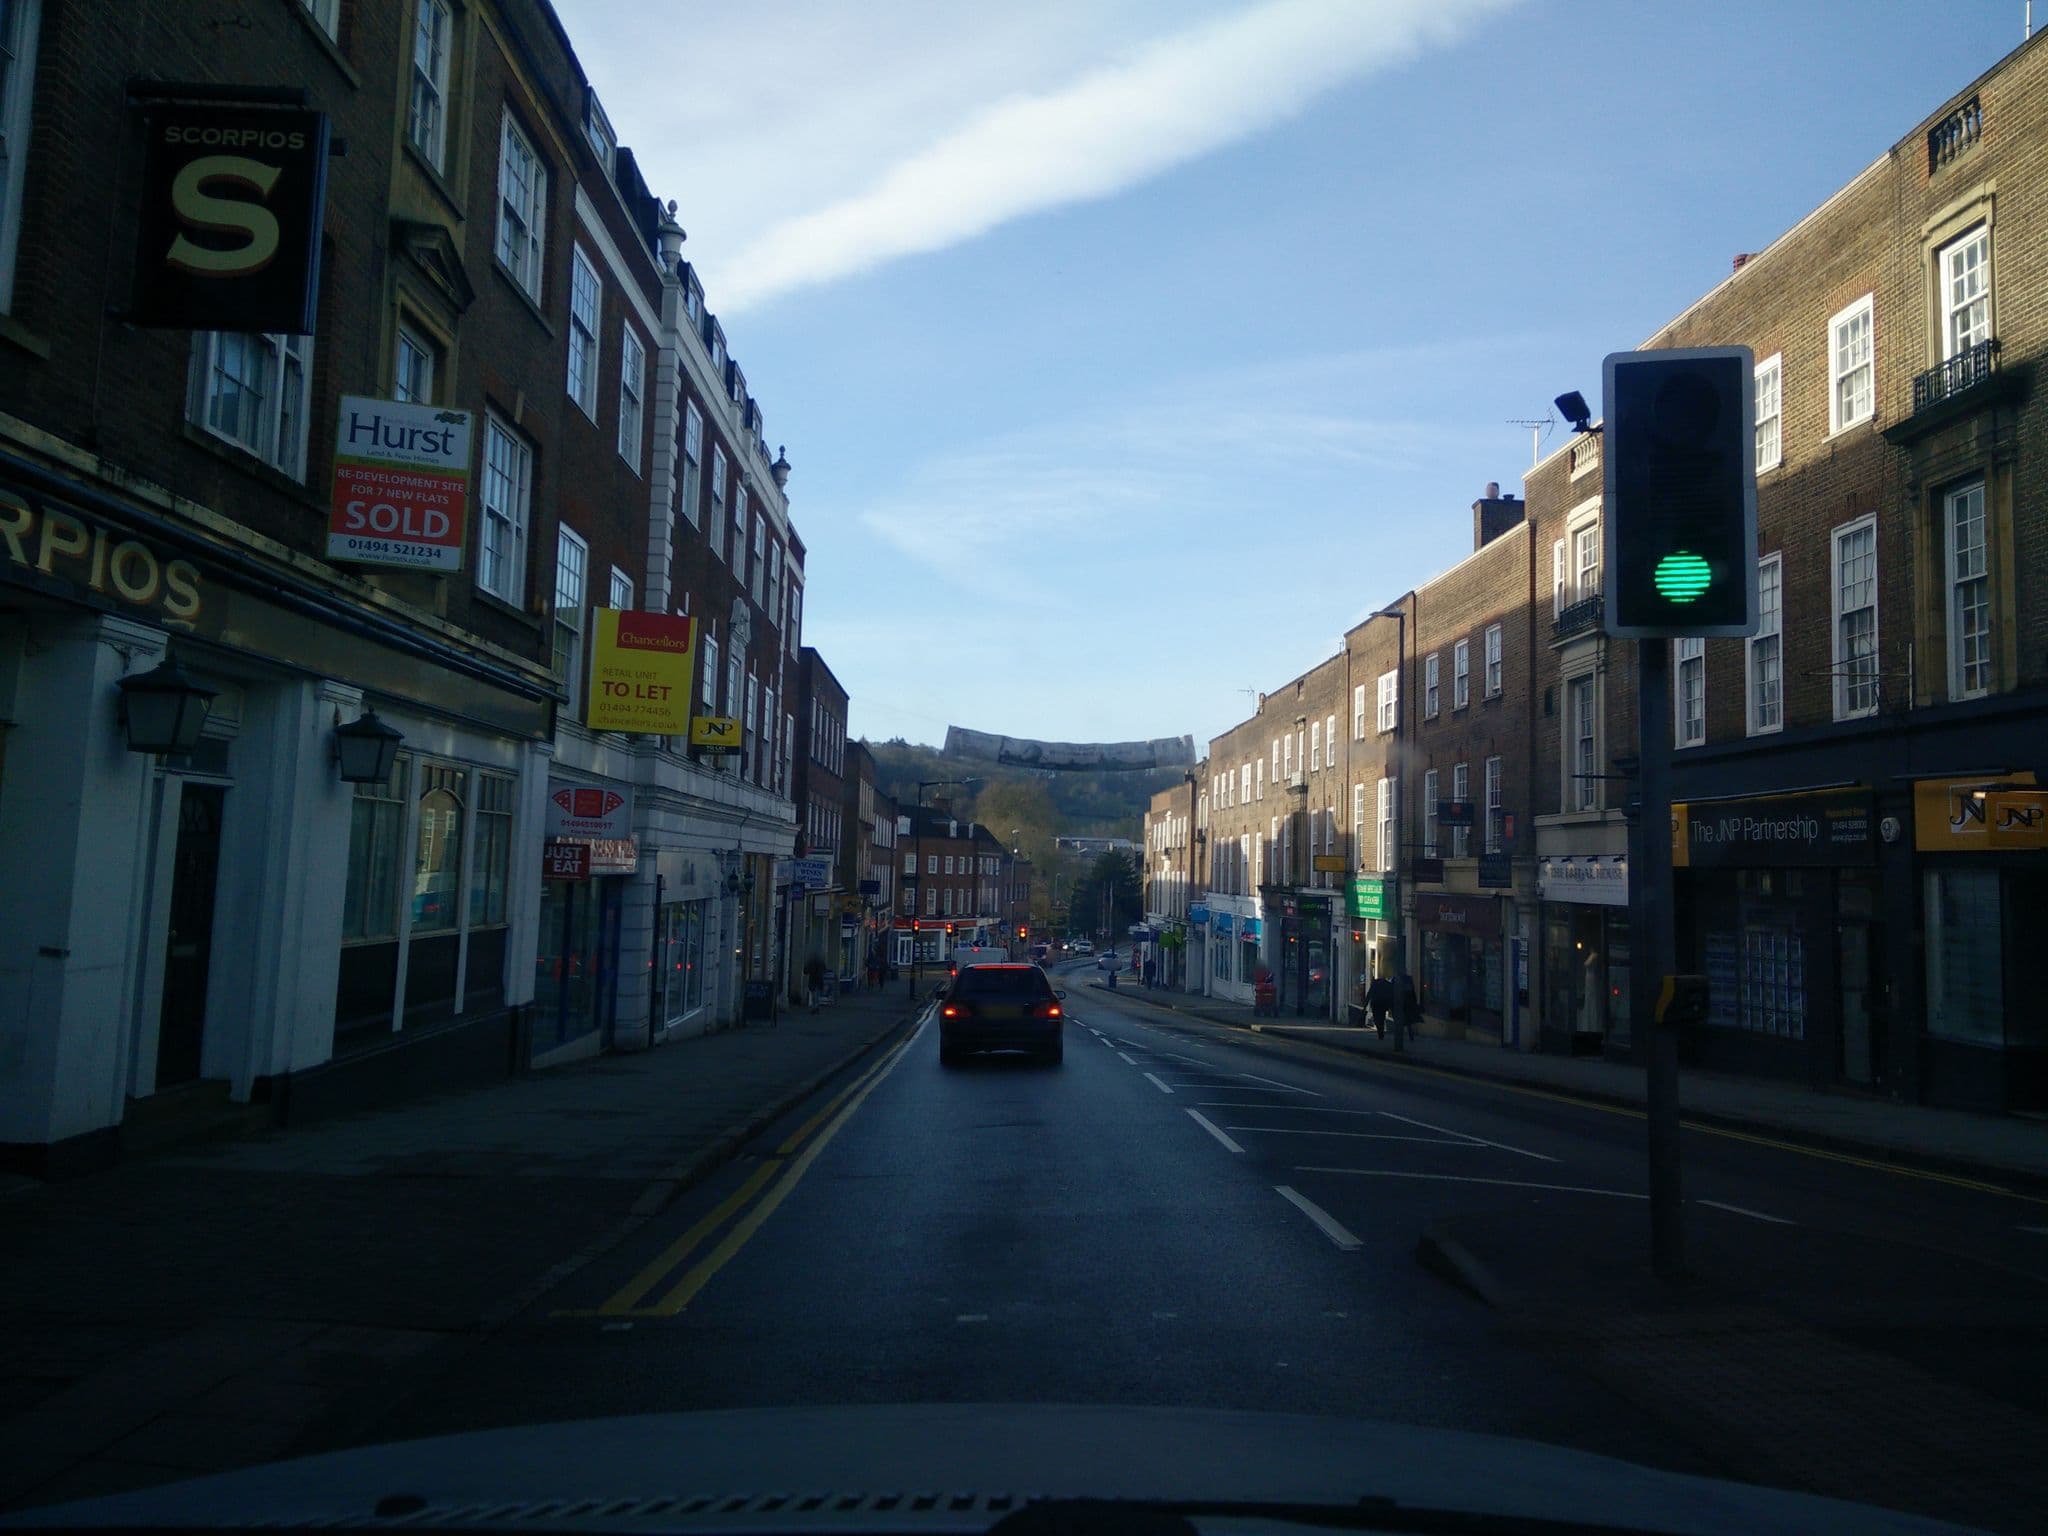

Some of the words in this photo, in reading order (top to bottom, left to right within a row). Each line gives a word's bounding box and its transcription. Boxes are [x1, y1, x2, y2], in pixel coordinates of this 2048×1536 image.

[163, 125, 306, 150] SCORPIOS
[165, 154, 283, 278] S
[348, 412, 455, 456] Hurst
[337, 468, 438, 489] RE-DEVELOPMENT
[441, 481, 465, 493] SITE
[351, 484, 374, 495] FOR
[377, 487, 383, 496] 7
[386, 489, 414, 500] NEW
[416, 492, 449, 505] FLATS
[345, 500, 450, 538] SOLD
[0, 488, 203, 618] RPIOS
[348, 538, 389, 553] 01494
[394, 543, 441, 558] 521234
[620, 631, 687, 649] Chancellors
[602, 666, 632, 679] RETAIL
[635, 670, 657, 680] UNIT
[602, 681, 630, 697] TO
[636, 684, 672, 701] LET
[599, 702, 631, 713] 01494
[700, 722, 733, 736] JNP
[1691, 820, 1713, 843] The
[1715, 817, 1742, 842] JNP
[1744, 813, 1819, 845] Partnership
[545, 846, 582, 860] JUST
[553, 860, 582, 873] EAT
